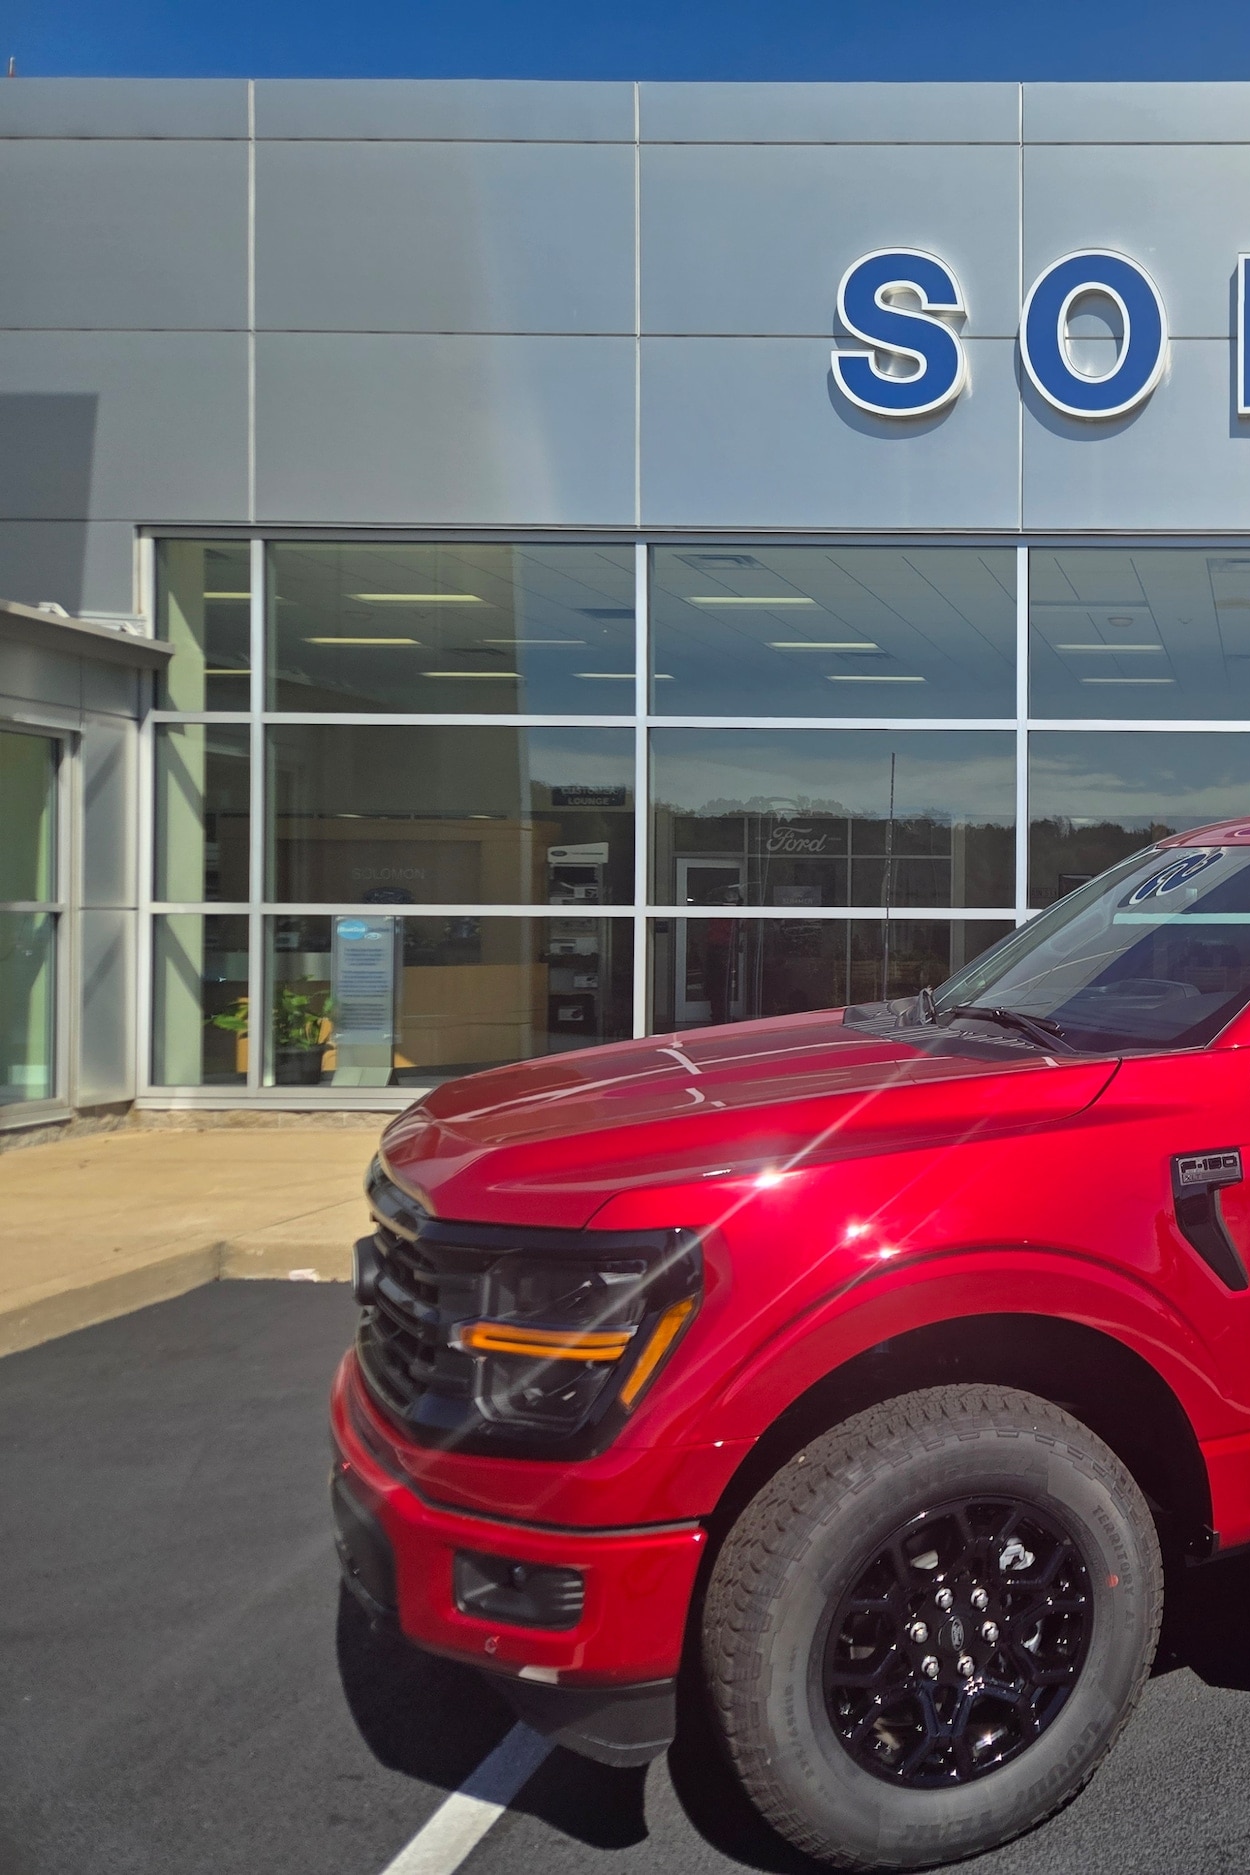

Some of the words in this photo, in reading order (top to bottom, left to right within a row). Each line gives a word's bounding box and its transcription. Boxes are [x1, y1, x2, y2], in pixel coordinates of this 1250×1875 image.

[567, 797, 610, 805] LOUNGE
[766, 826, 827, 852] Ford
[352, 867, 425, 880] SOLOMON
[1180, 1155, 1238, 1173] F-150
[1092, 1504, 1135, 1596] TERRITORY
